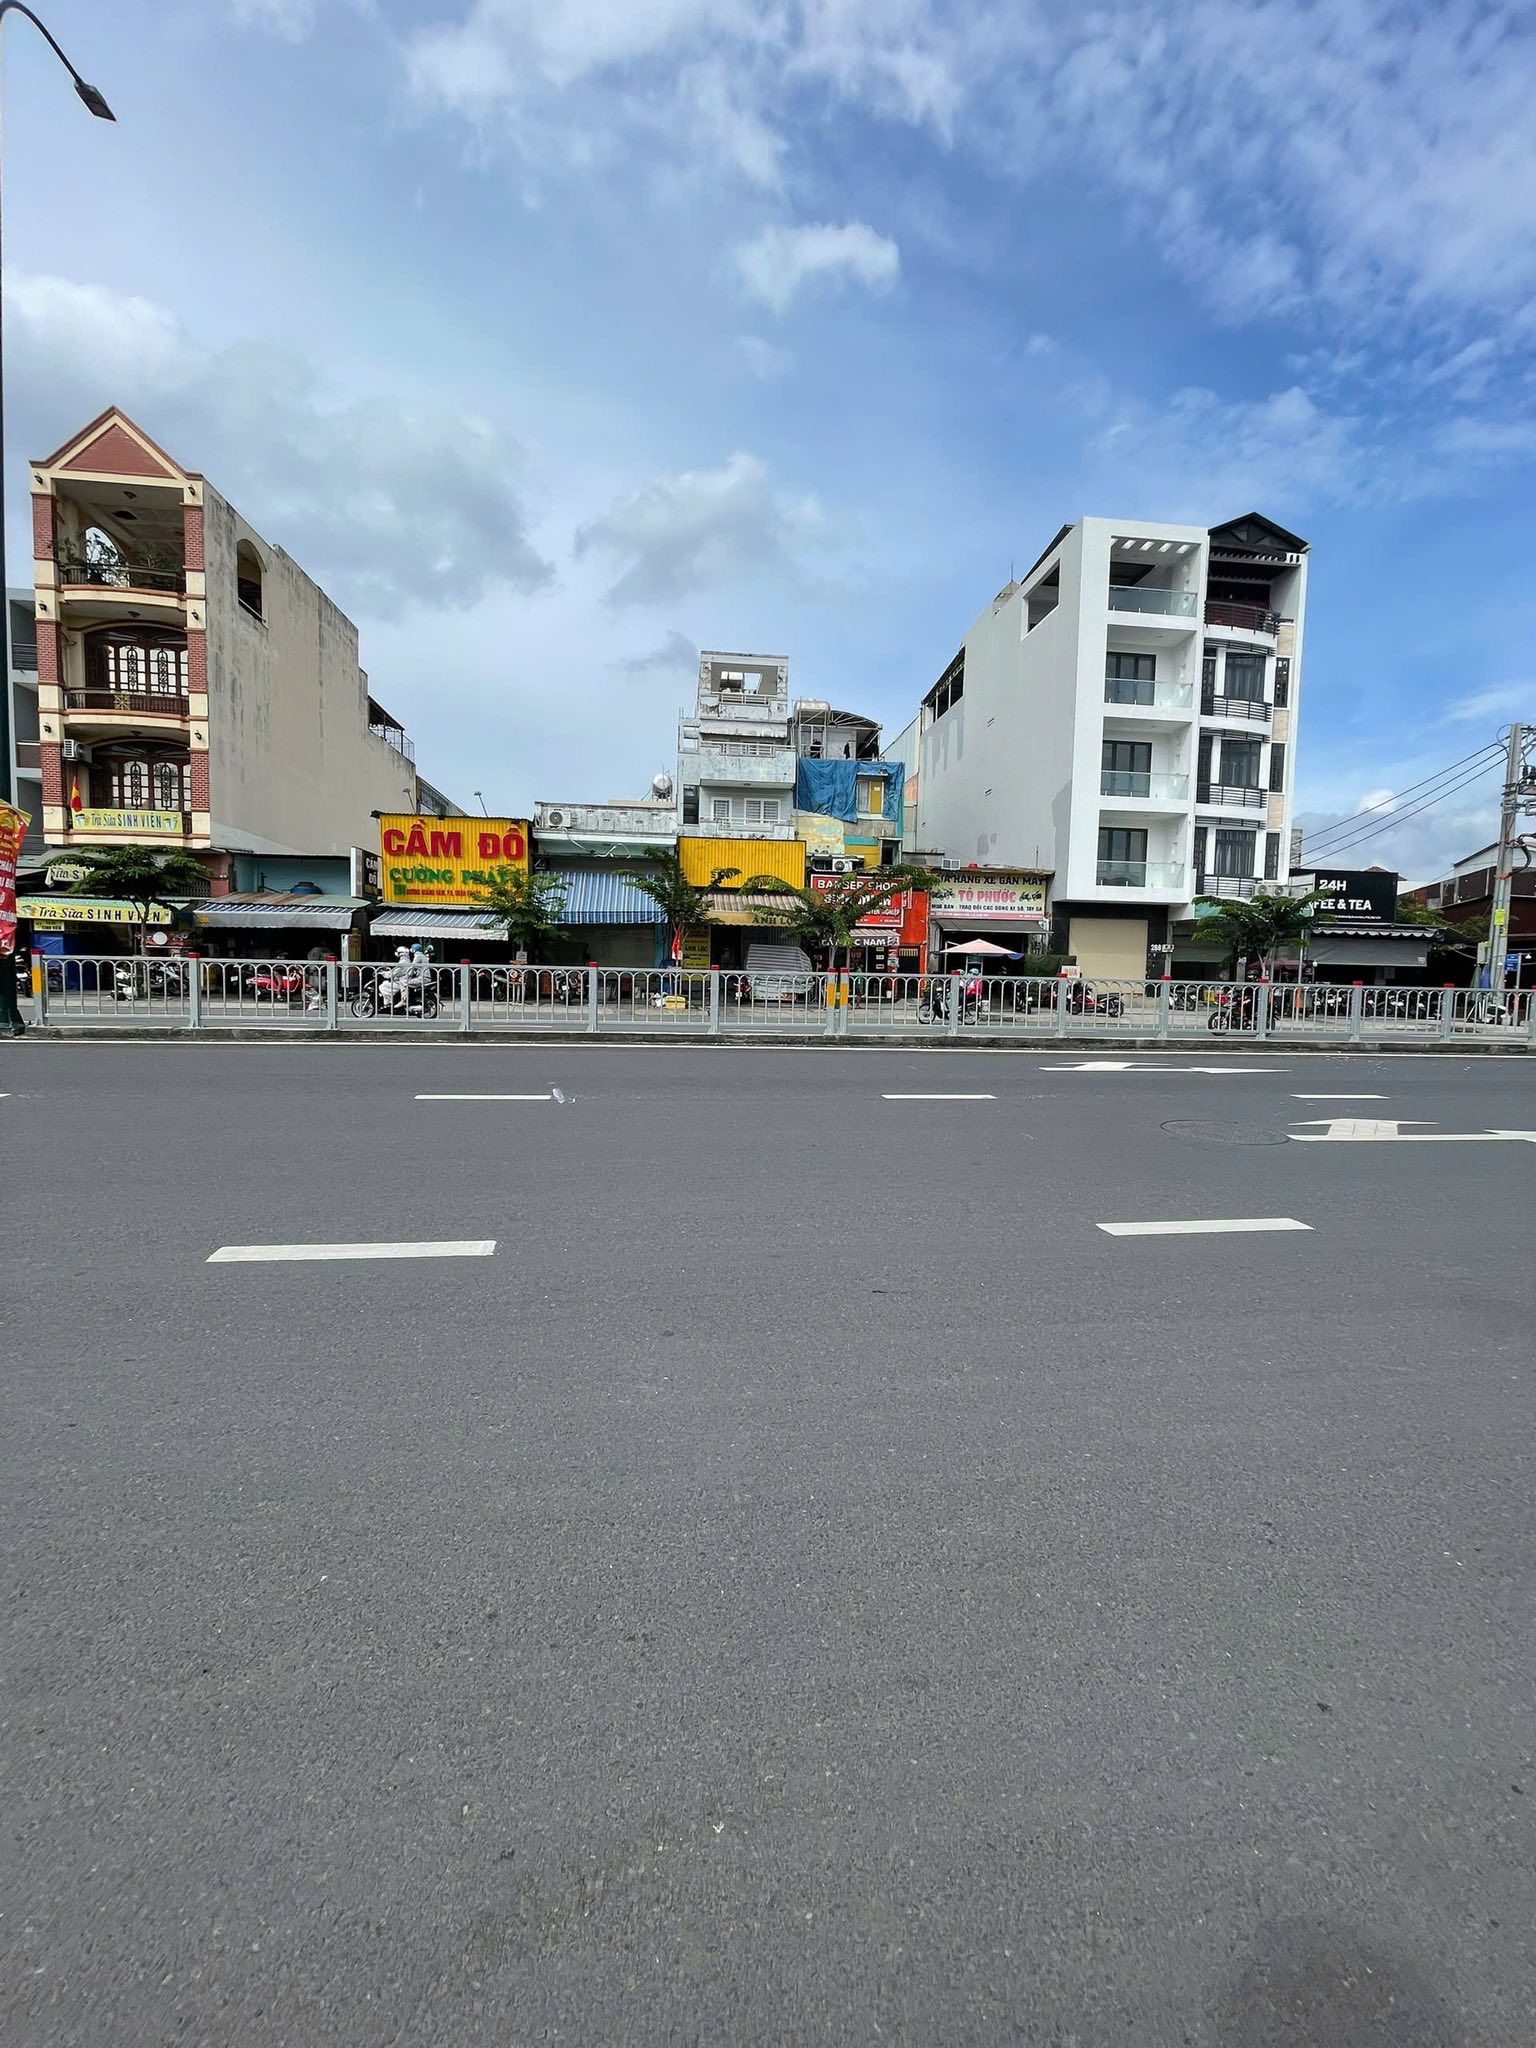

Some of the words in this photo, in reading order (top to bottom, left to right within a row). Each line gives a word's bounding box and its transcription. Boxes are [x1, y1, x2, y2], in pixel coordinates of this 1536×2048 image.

[91, 813, 102, 826] Trà
[117, 814, 138, 828] SINH
[142, 812, 162, 828] VIÊN
[383, 818, 463, 858] CẦM
[477, 821, 525, 861] ĐỒ
[389, 864, 455, 884] CƯỜNG
[983, 876, 996, 885] XE
[1319, 879, 1347, 891] 24H
[977, 888, 1017, 903] PHƯỚC
[1348, 899, 1372, 911] TEA
[37, 906, 57, 918] Trà
[60, 907, 83, 919] Sữa
[87, 909, 122, 920] SINH
[863, 938, 886, 946] NAM
